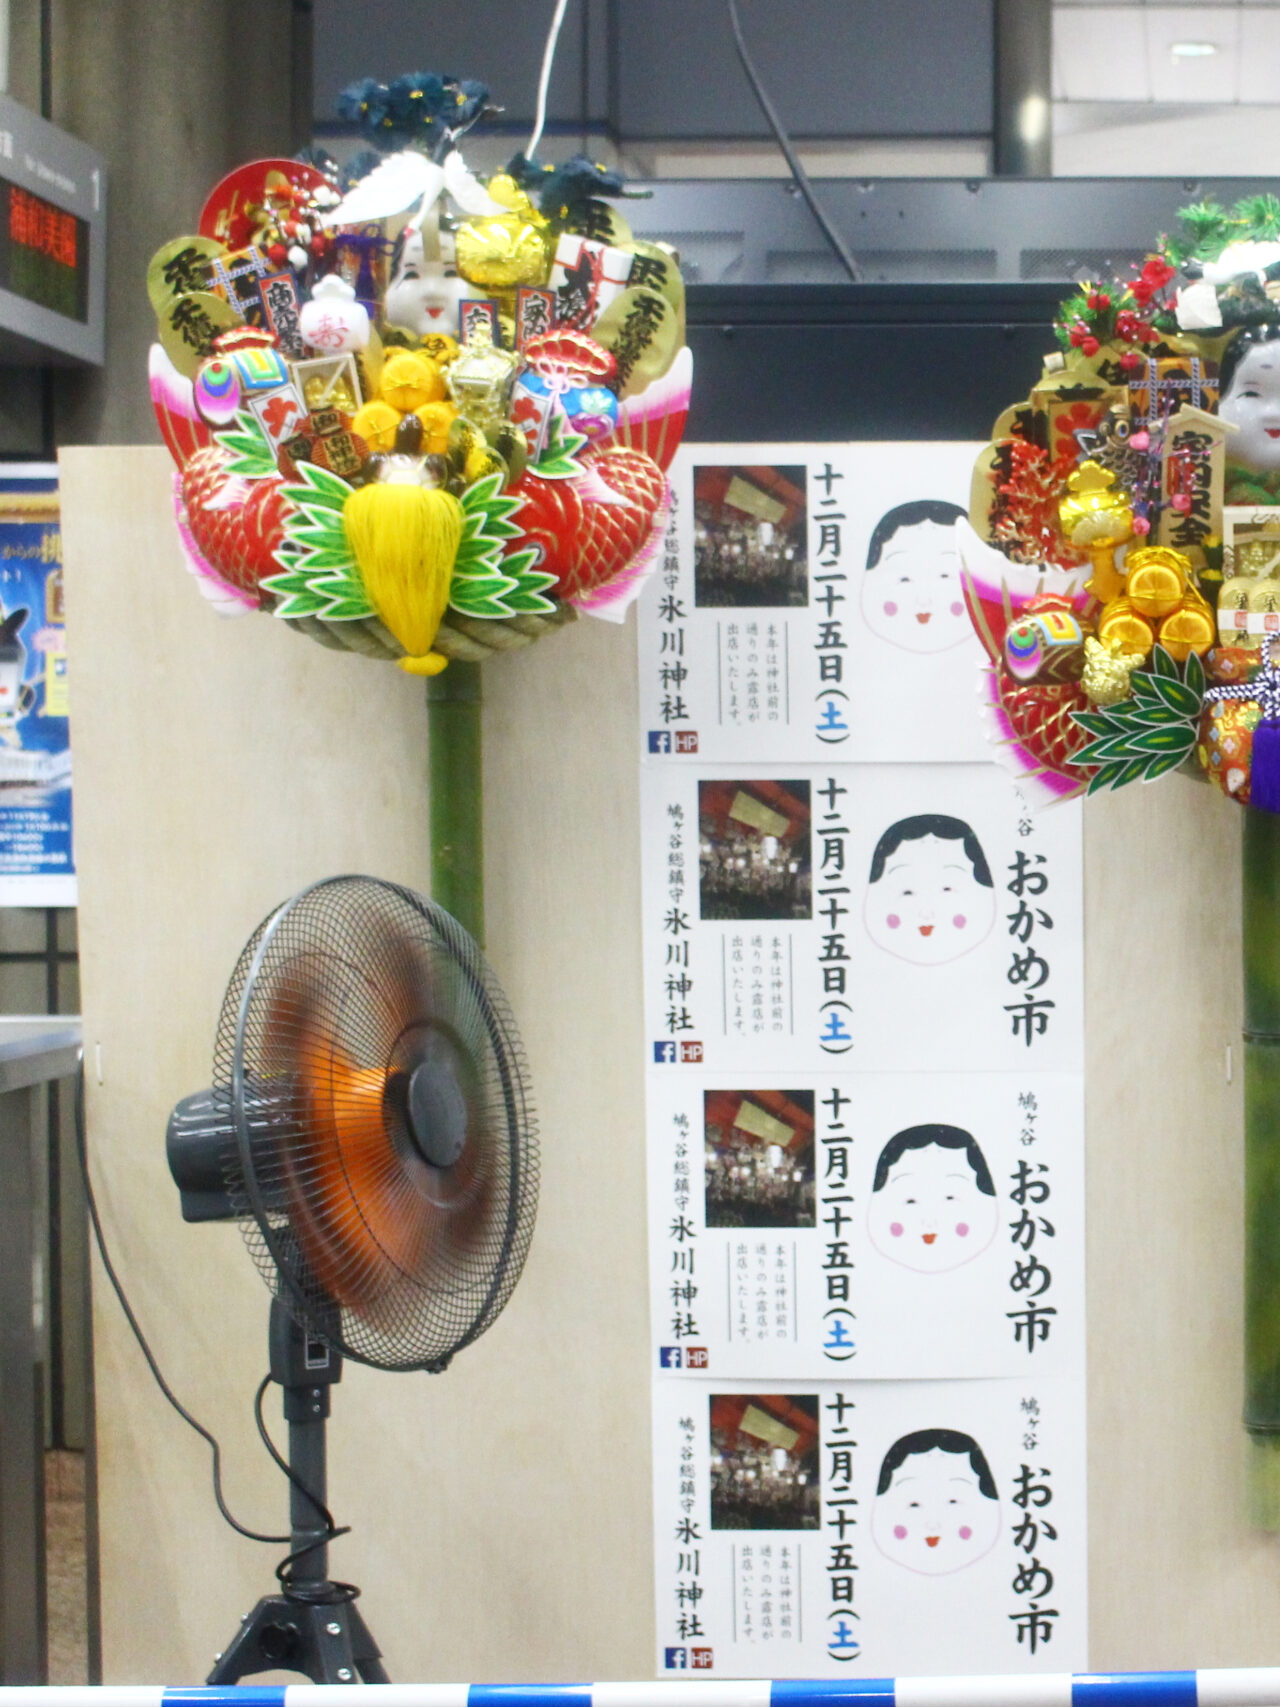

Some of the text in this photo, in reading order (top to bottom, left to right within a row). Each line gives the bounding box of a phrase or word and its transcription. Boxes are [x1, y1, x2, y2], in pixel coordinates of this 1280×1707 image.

[309, 313, 350, 348] 寿
[1003, 851, 1055, 1047] おかめ市
[1006, 1159, 1057, 1353] おかめ市
[1008, 1463, 1059, 1655] おかめ市
